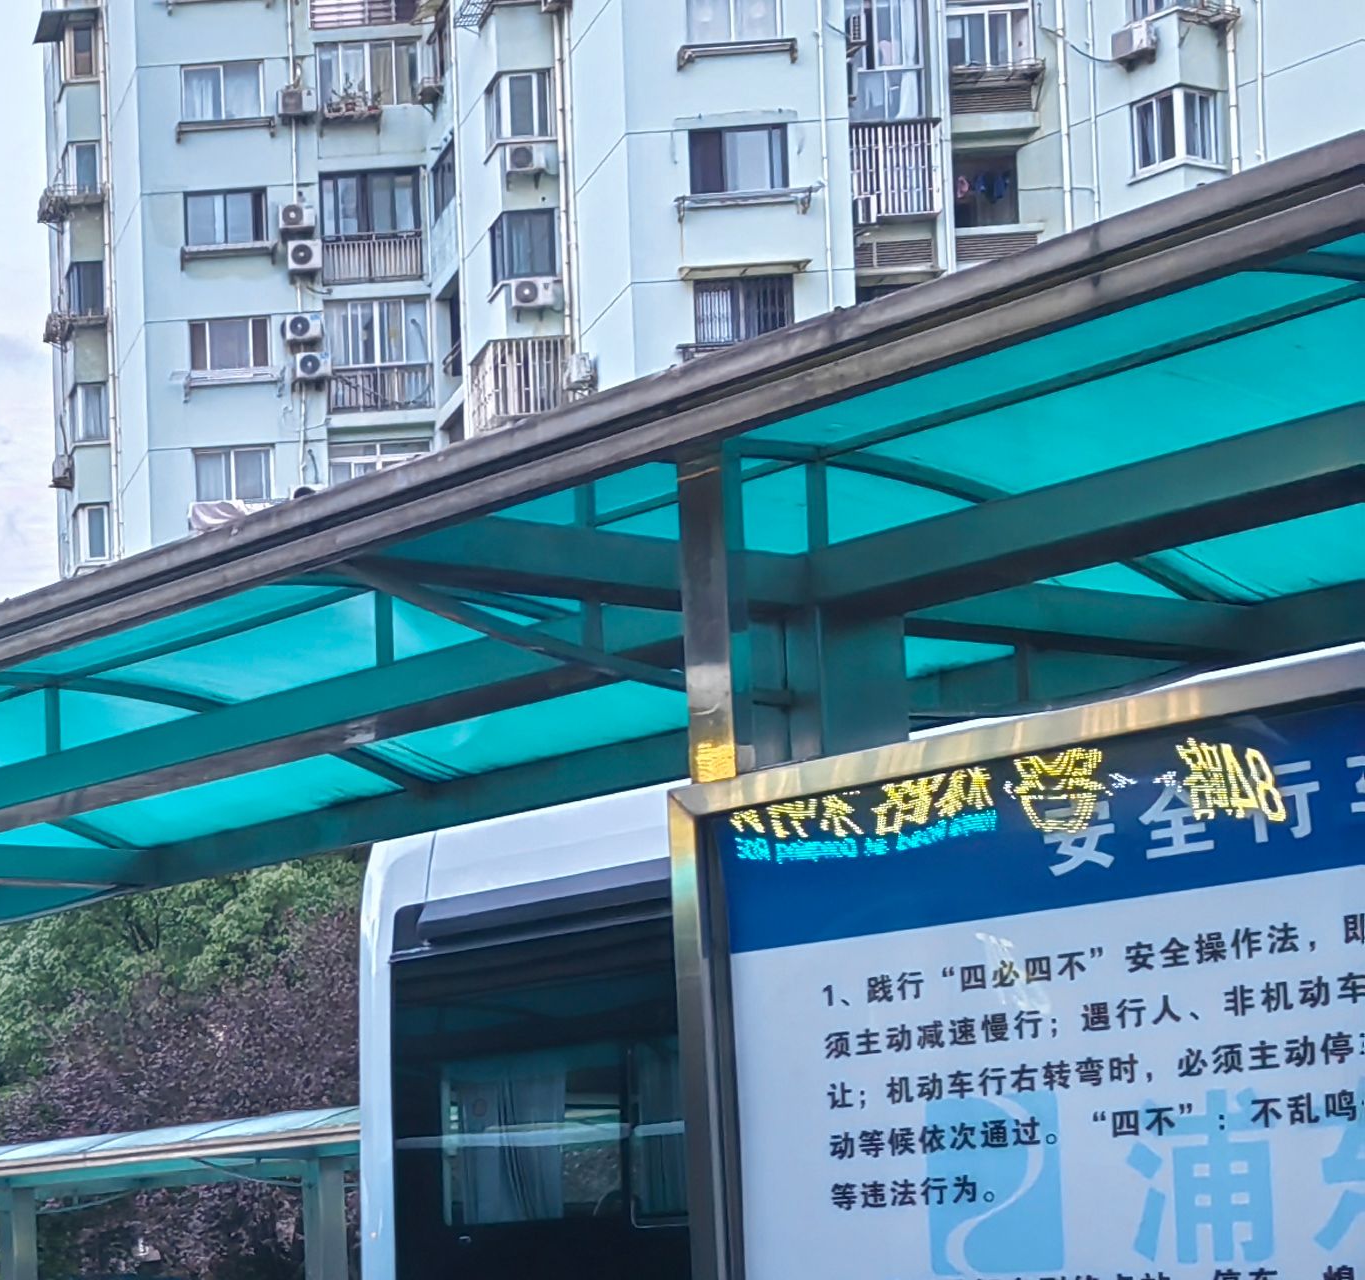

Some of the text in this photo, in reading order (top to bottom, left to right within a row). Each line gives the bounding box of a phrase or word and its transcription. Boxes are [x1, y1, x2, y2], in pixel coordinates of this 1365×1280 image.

[1043, 755, 1365, 877] 安全行
[826, 1031, 1365, 1110] 让；机动车行右转弯时，必须主动停
[829, 1089, 1365, 1160] 动等候依次通过。“四不”：不乱鸣
[830, 1174, 996, 1211] 等违法行为。
